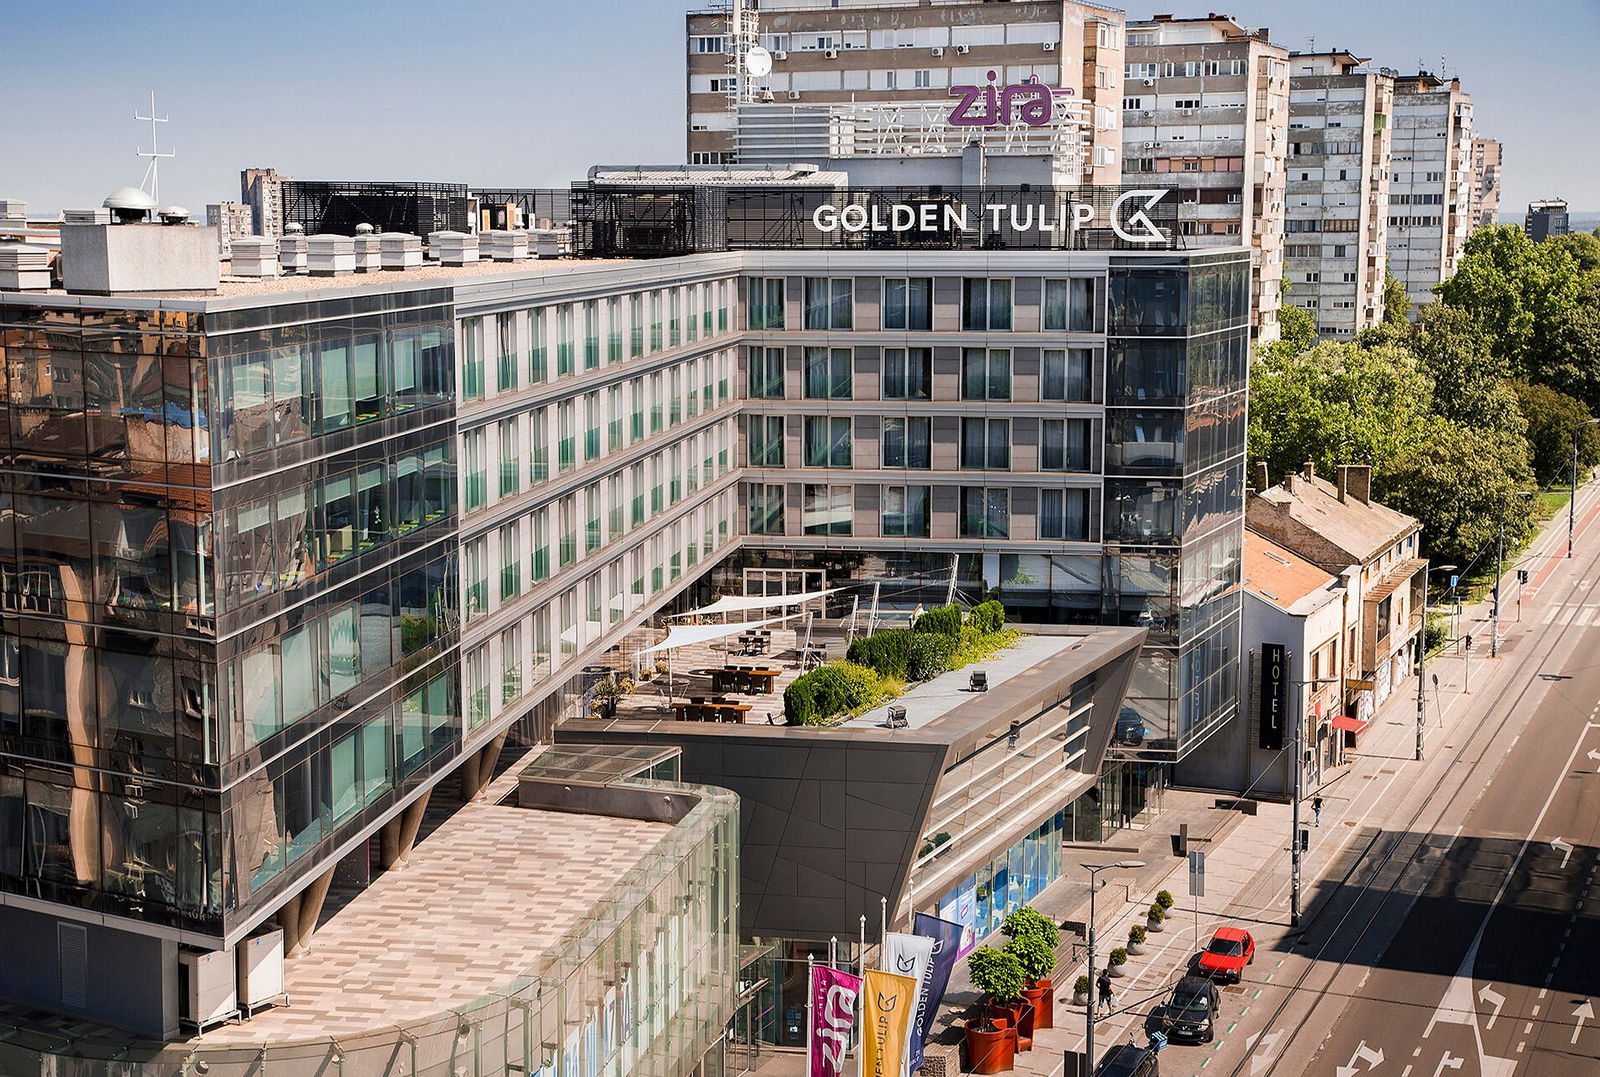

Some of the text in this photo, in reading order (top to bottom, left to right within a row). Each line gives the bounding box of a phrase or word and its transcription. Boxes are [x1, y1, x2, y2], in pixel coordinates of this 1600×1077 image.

[949, 70, 1053, 126] zira
[812, 204, 1096, 232] GOLDEN TULIP
[1271, 649, 1280, 729] HOTEL
[816, 984, 857, 1074] zira
[876, 1015, 889, 1054] TULIP
[916, 988, 930, 1037] GOLDEN
